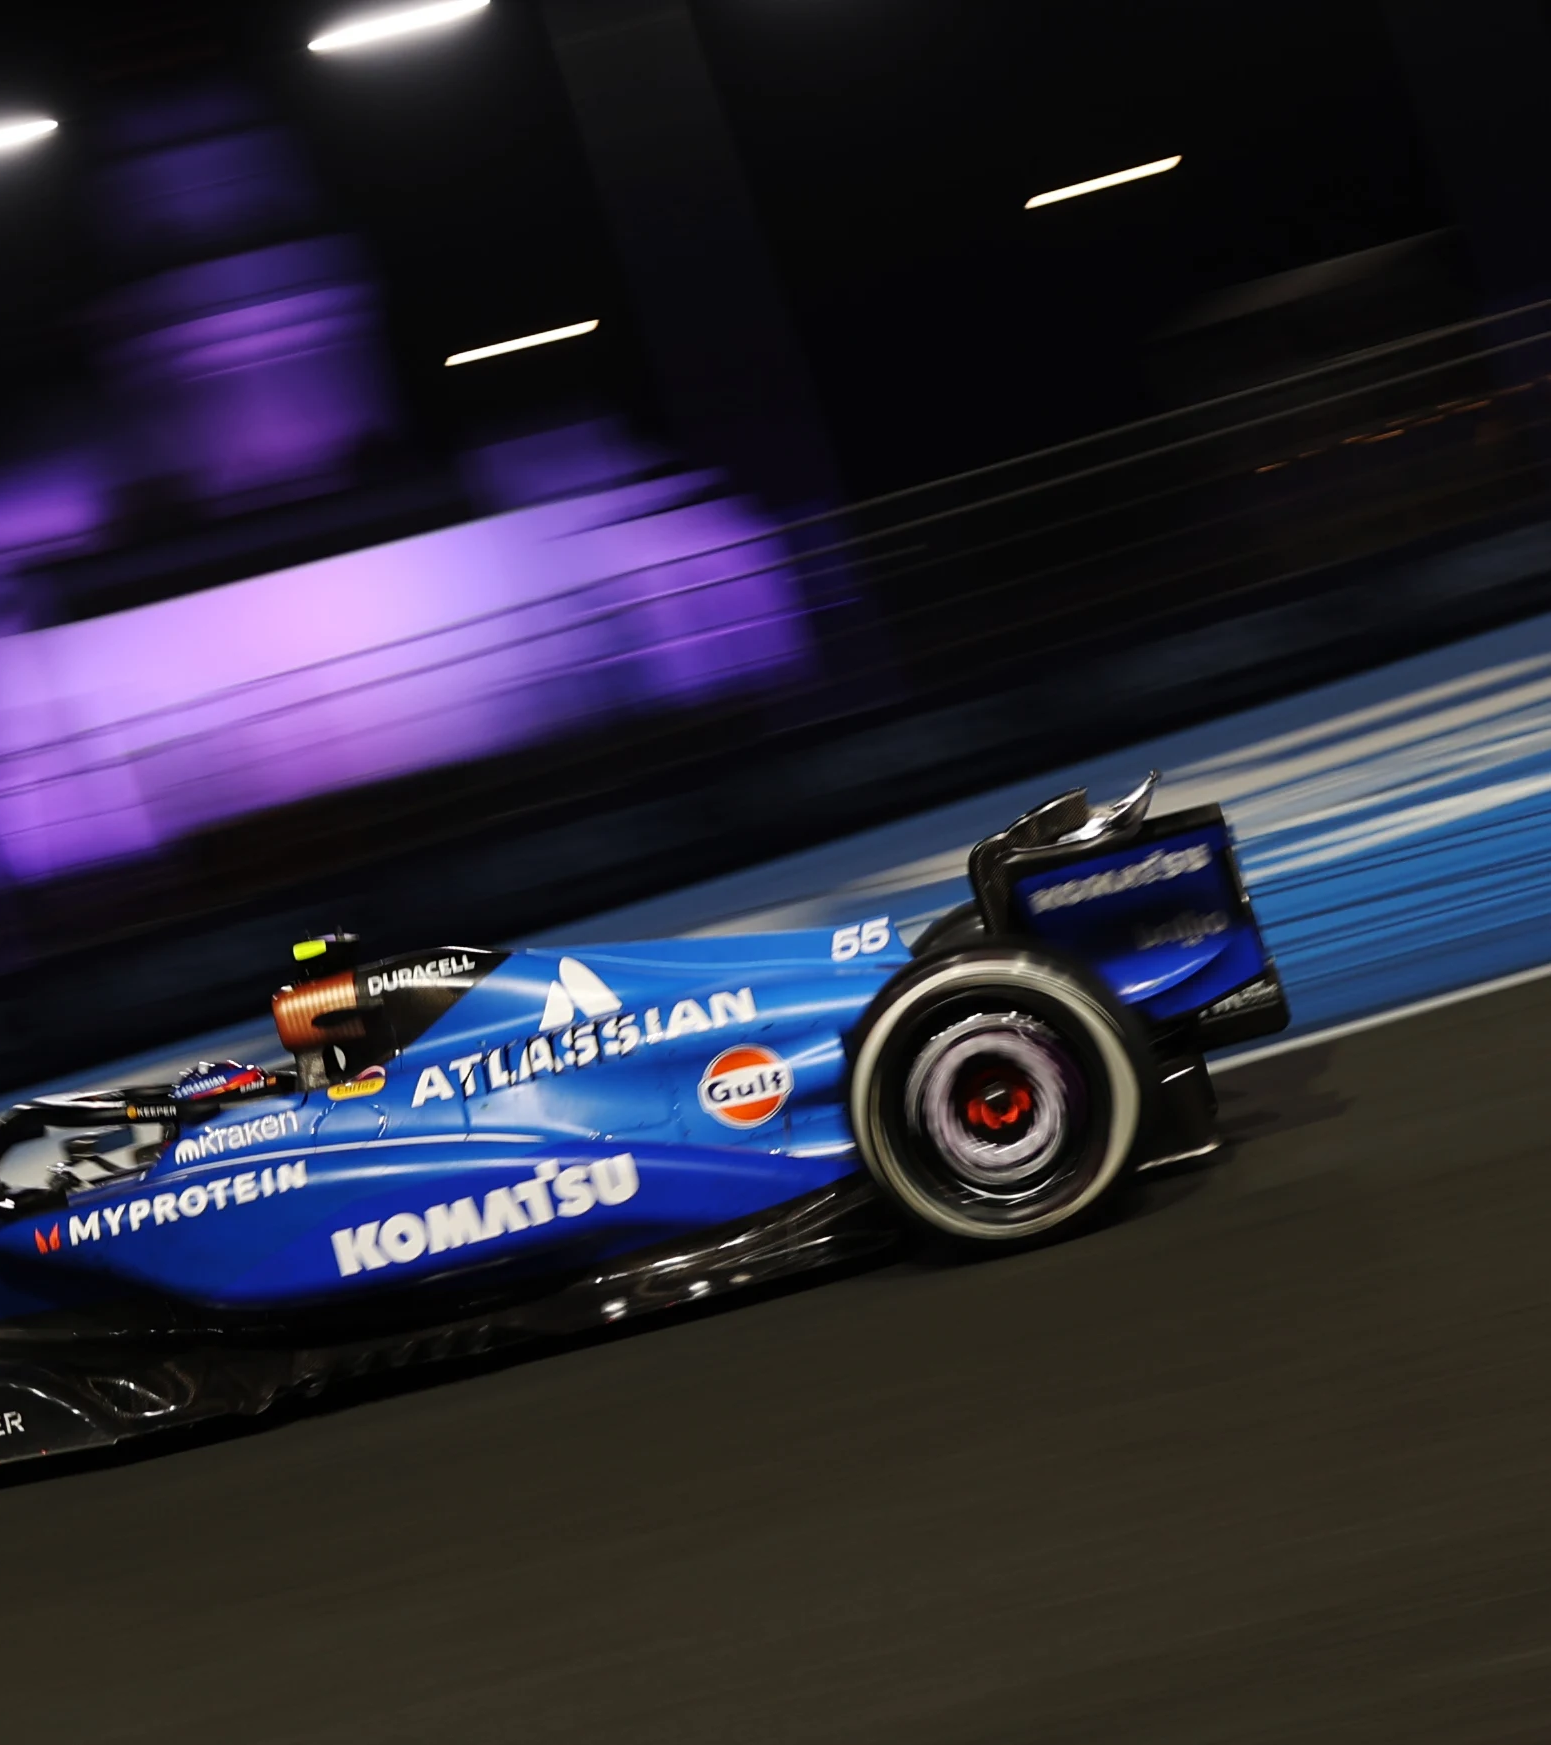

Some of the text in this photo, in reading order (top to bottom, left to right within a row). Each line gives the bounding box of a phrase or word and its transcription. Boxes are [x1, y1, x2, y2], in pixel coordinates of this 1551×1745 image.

[831, 916, 891, 962] 55
[367, 954, 475, 997] DURACELL
[411, 986, 758, 1108] ATLASSIAN
[707, 1070, 784, 1102] Gulf
[136, 1104, 177, 1118] KEEPER
[198, 1110, 299, 1158] kraken
[67, 1159, 309, 1247] MYPROTEIN
[330, 1151, 641, 1277] KOMATSU
